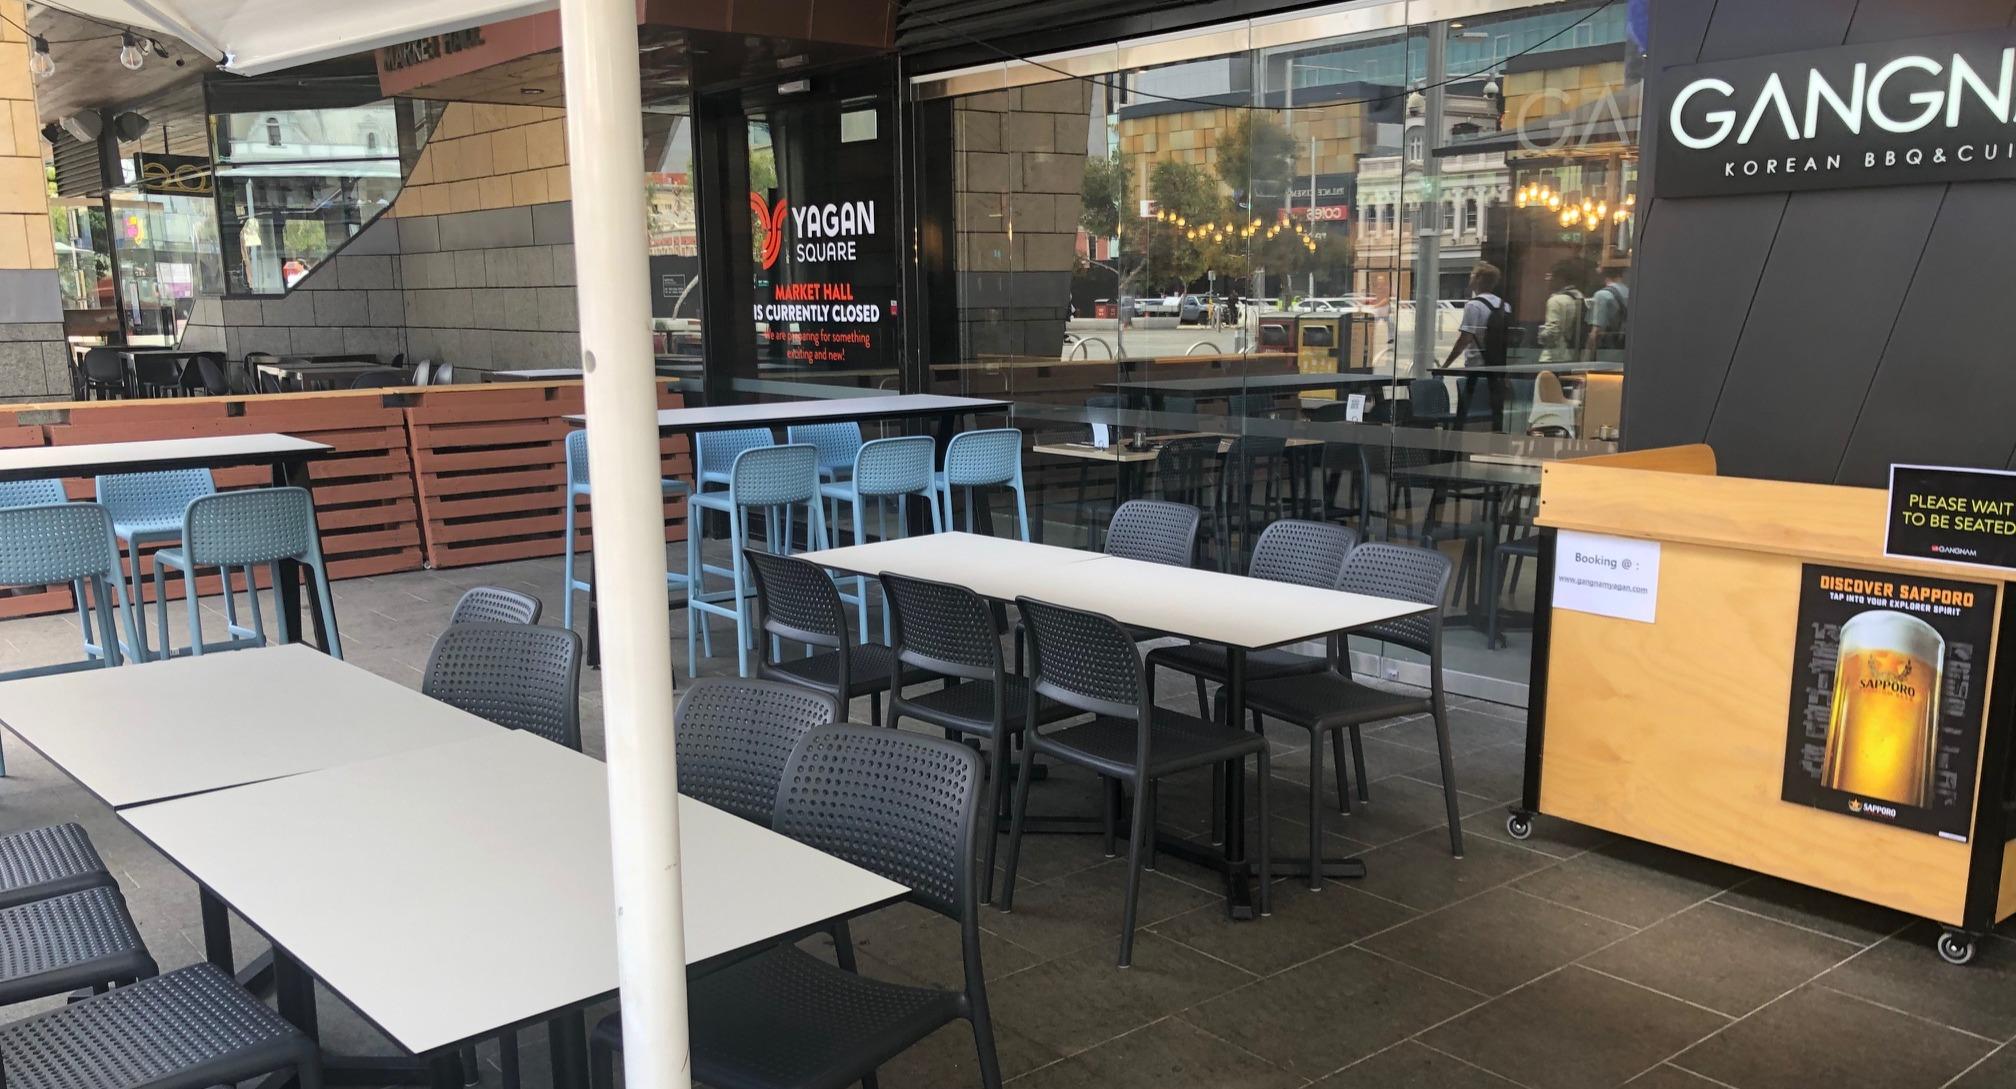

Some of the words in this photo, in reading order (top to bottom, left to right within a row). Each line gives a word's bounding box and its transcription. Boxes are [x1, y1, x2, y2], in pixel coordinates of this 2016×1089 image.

[1670, 47, 2016, 149] GANGN
[1725, 155, 1841, 177] KOREAN
[791, 200, 875, 239] YAGAN
[796, 241, 857, 263] SQUARE
[775, 283, 820, 301] MARKET
[823, 282, 854, 301] HALL
[753, 304, 763, 321] IS
[765, 304, 829, 322] CURRENTLY
[832, 304, 880, 322] CLOSED
[776, 329, 787, 341] are
[820, 328, 832, 342] for
[832, 330, 871, 348] something
[814, 346, 827, 360] and
[828, 348, 845, 361] new!
[1909, 494, 1967, 512] PLEASE
[1971, 499, 2014, 516] WAIT
[1902, 511, 1925, 526] TO
[1930, 514, 1950, 529] BE
[1954, 516, 2016, 535] SEATED
[1575, 552, 1617, 570] Booking
[1622, 558, 1632, 570] @
[1938, 545, 1977, 557] GANGNAM
[1820, 575, 1894, 597] DISCOVER
[1900, 584, 1974, 608] SAPPORO
[1829, 591, 1844, 601] TAP
[1846, 593, 1865, 604] INTO
[1866, 596, 1887, 608] YOUR
[1889, 599, 1931, 613] EXPLORER
[1933, 605, 1961, 616] SPIRIT
[1860, 680, 1915, 697] SAPPORO
[1863, 803, 1896, 817] SAPPORO
